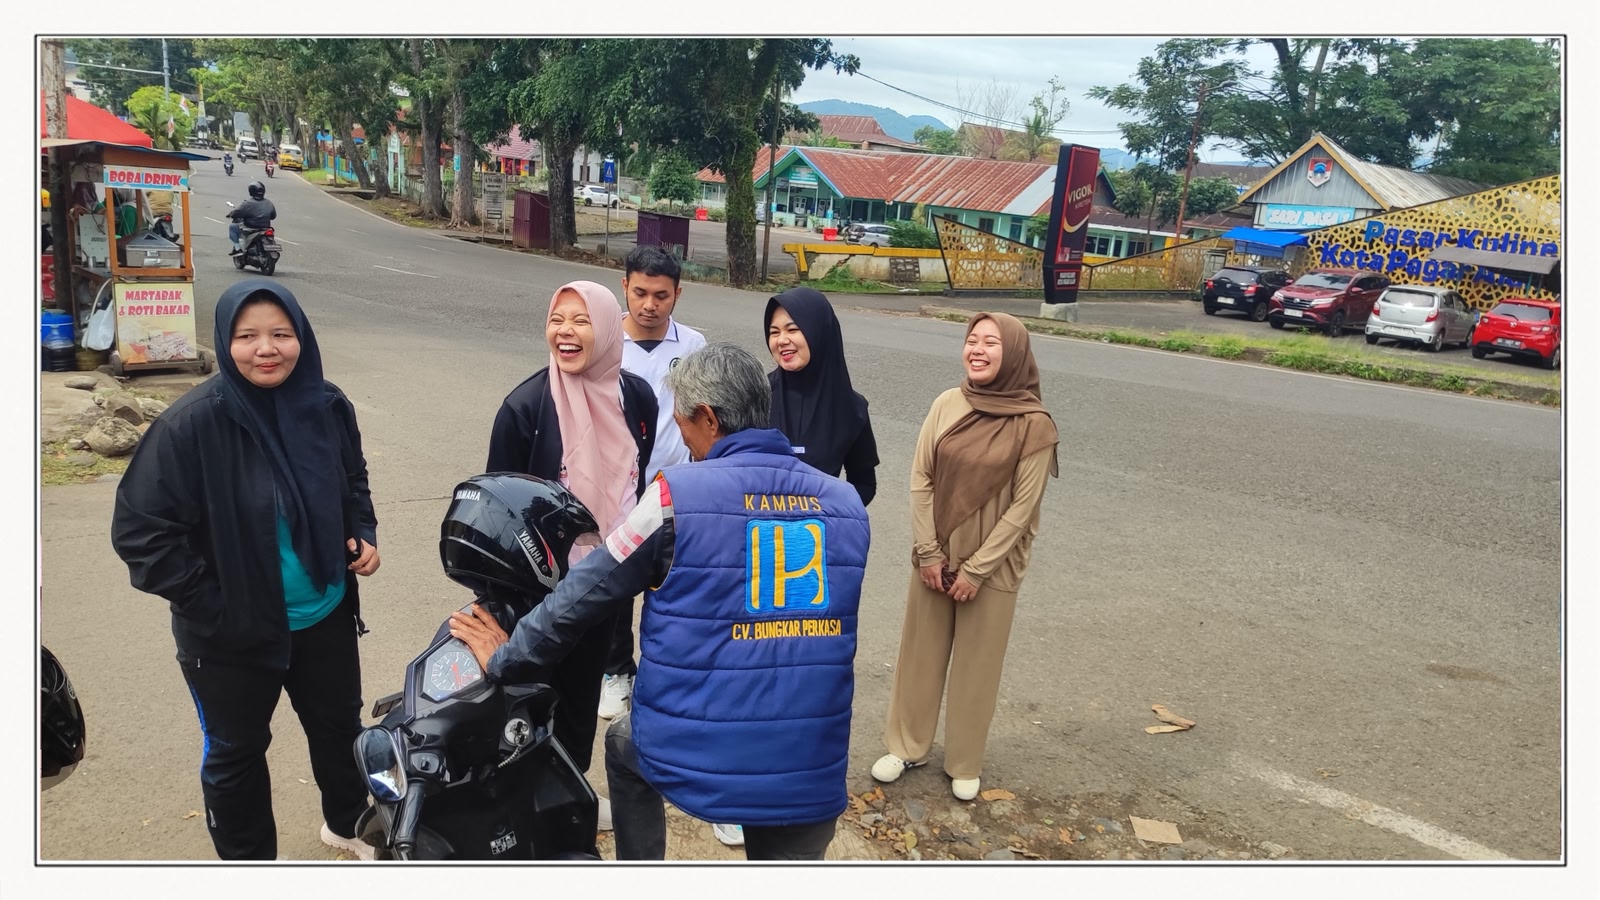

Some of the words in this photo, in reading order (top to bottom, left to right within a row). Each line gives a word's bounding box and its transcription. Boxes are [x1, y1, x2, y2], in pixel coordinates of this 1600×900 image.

[109, 170, 141, 184] BOBA
[144, 172, 181, 186] DRINK
[1068, 183, 1093, 204] VIGOR
[1364, 220, 1450, 249] Pasar
[1320, 241, 1384, 271] Kota
[1387, 249, 1473, 283] Pagar
[125, 290, 182, 301] MARTABAK
[128, 305, 154, 316] ROTI
[156, 304, 190, 315] BAKAR
[744, 494, 822, 511] KAMPUS
[518, 530, 544, 565] YAMAHA
[732, 623, 753, 640] CV.
[754, 620, 801, 640] BUNGKAR
[802, 619, 842, 637] PERKASA
